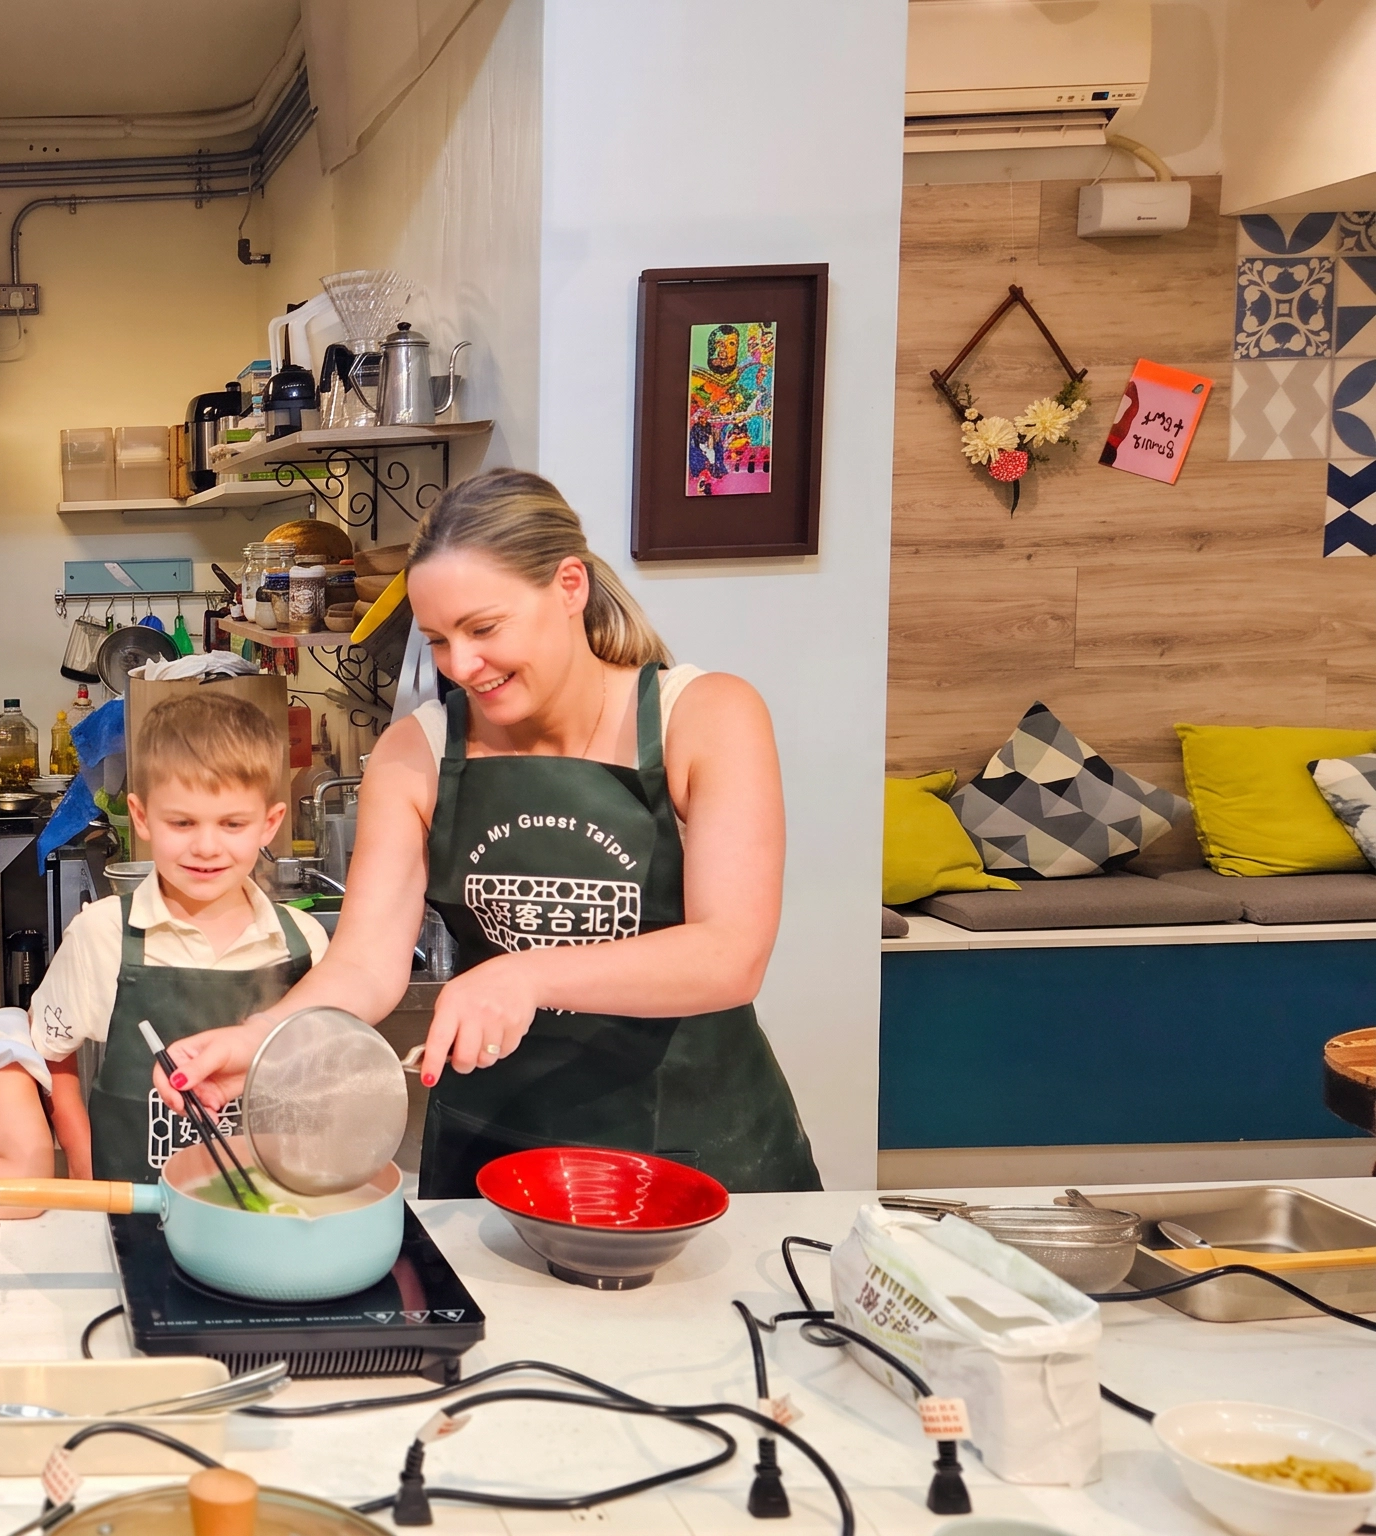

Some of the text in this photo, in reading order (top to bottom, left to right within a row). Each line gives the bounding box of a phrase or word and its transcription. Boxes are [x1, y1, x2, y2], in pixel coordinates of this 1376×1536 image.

[487, 822, 511, 842] My
[518, 814, 577, 831] Guest
[491, 901, 610, 933] 好客台北
